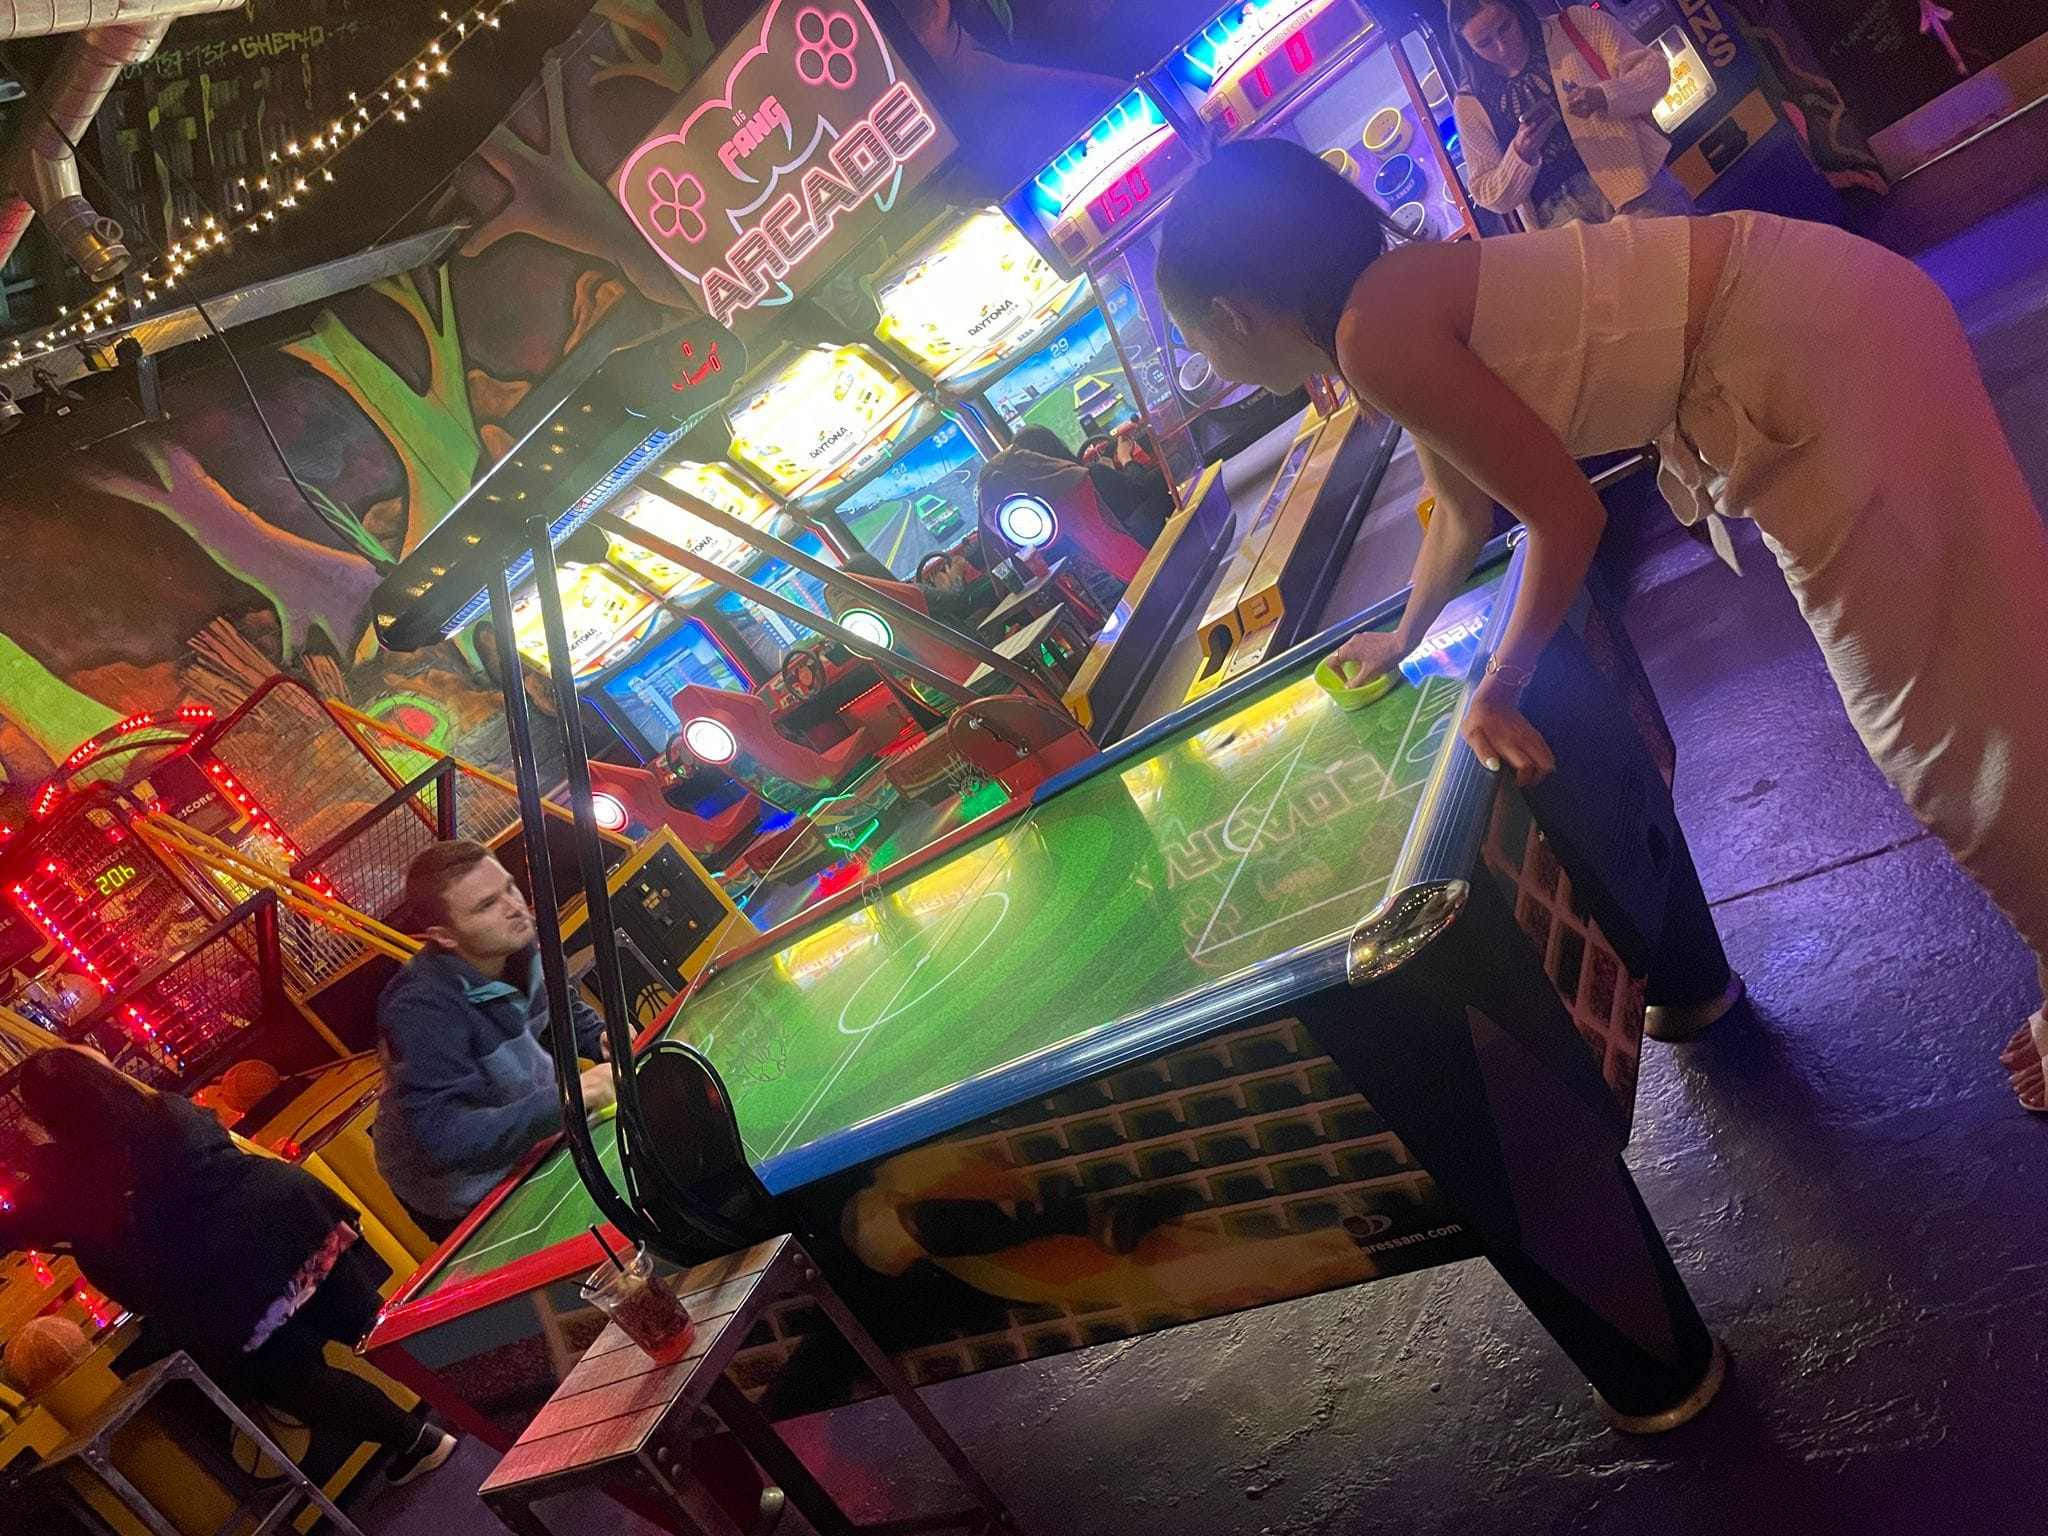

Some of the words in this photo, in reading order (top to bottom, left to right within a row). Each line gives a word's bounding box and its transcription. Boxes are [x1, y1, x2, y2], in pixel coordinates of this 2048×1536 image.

[717, 95, 793, 184] FANG
[700, 82, 936, 329] ARCADE
[1099, 165, 1152, 225] 150
[967, 299, 1014, 336] DAYTONA
[808, 426, 849, 459] DAYTONA
